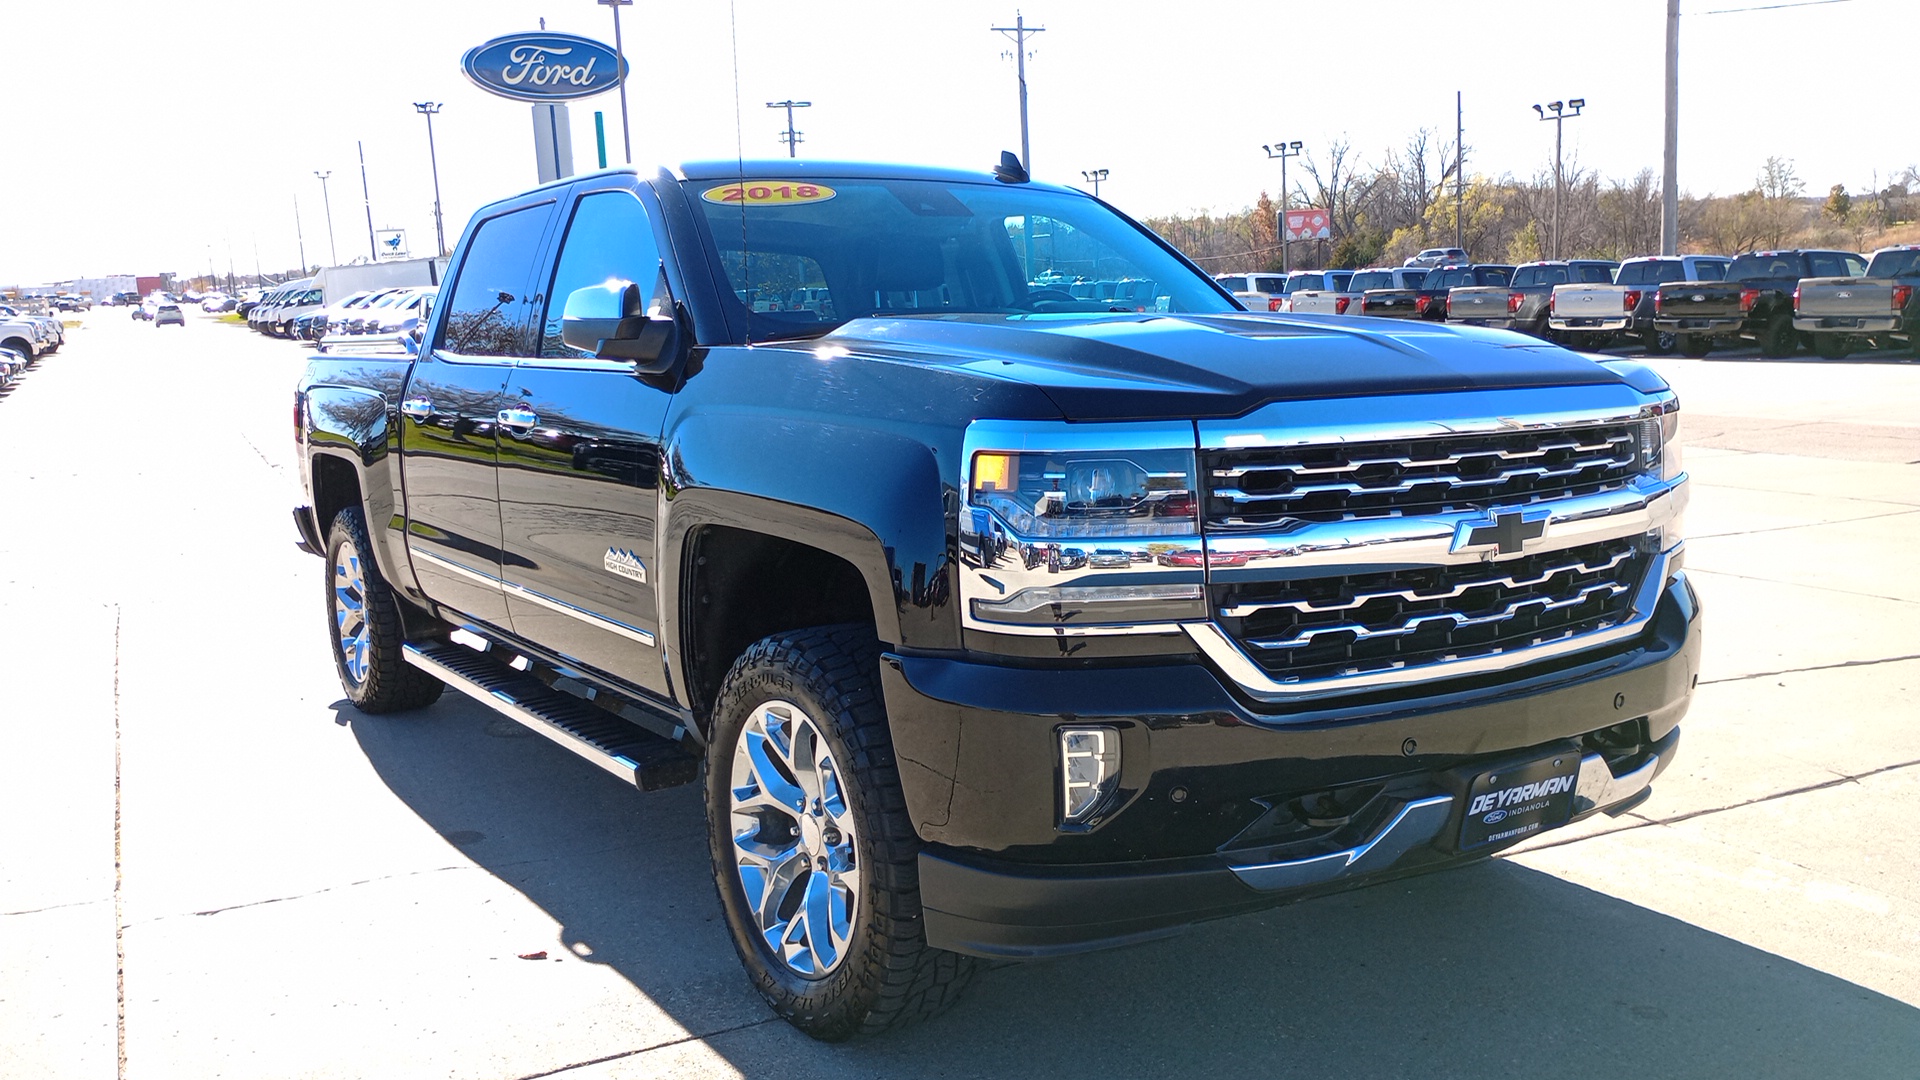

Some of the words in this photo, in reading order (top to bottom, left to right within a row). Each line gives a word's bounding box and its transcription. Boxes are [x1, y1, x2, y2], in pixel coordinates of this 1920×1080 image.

[502, 45, 597, 86] Ford
[722, 186, 820, 201] 2018
[606, 561, 617, 571] HIGH
[618, 564, 643, 579] COUNTRY
[734, 673, 793, 706] HERCULES
[1469, 775, 1574, 816] DEYARMAN
[1509, 800, 1550, 817] INDIANOLA
[1488, 822, 1539, 842] DEYARMANFORD.COM
